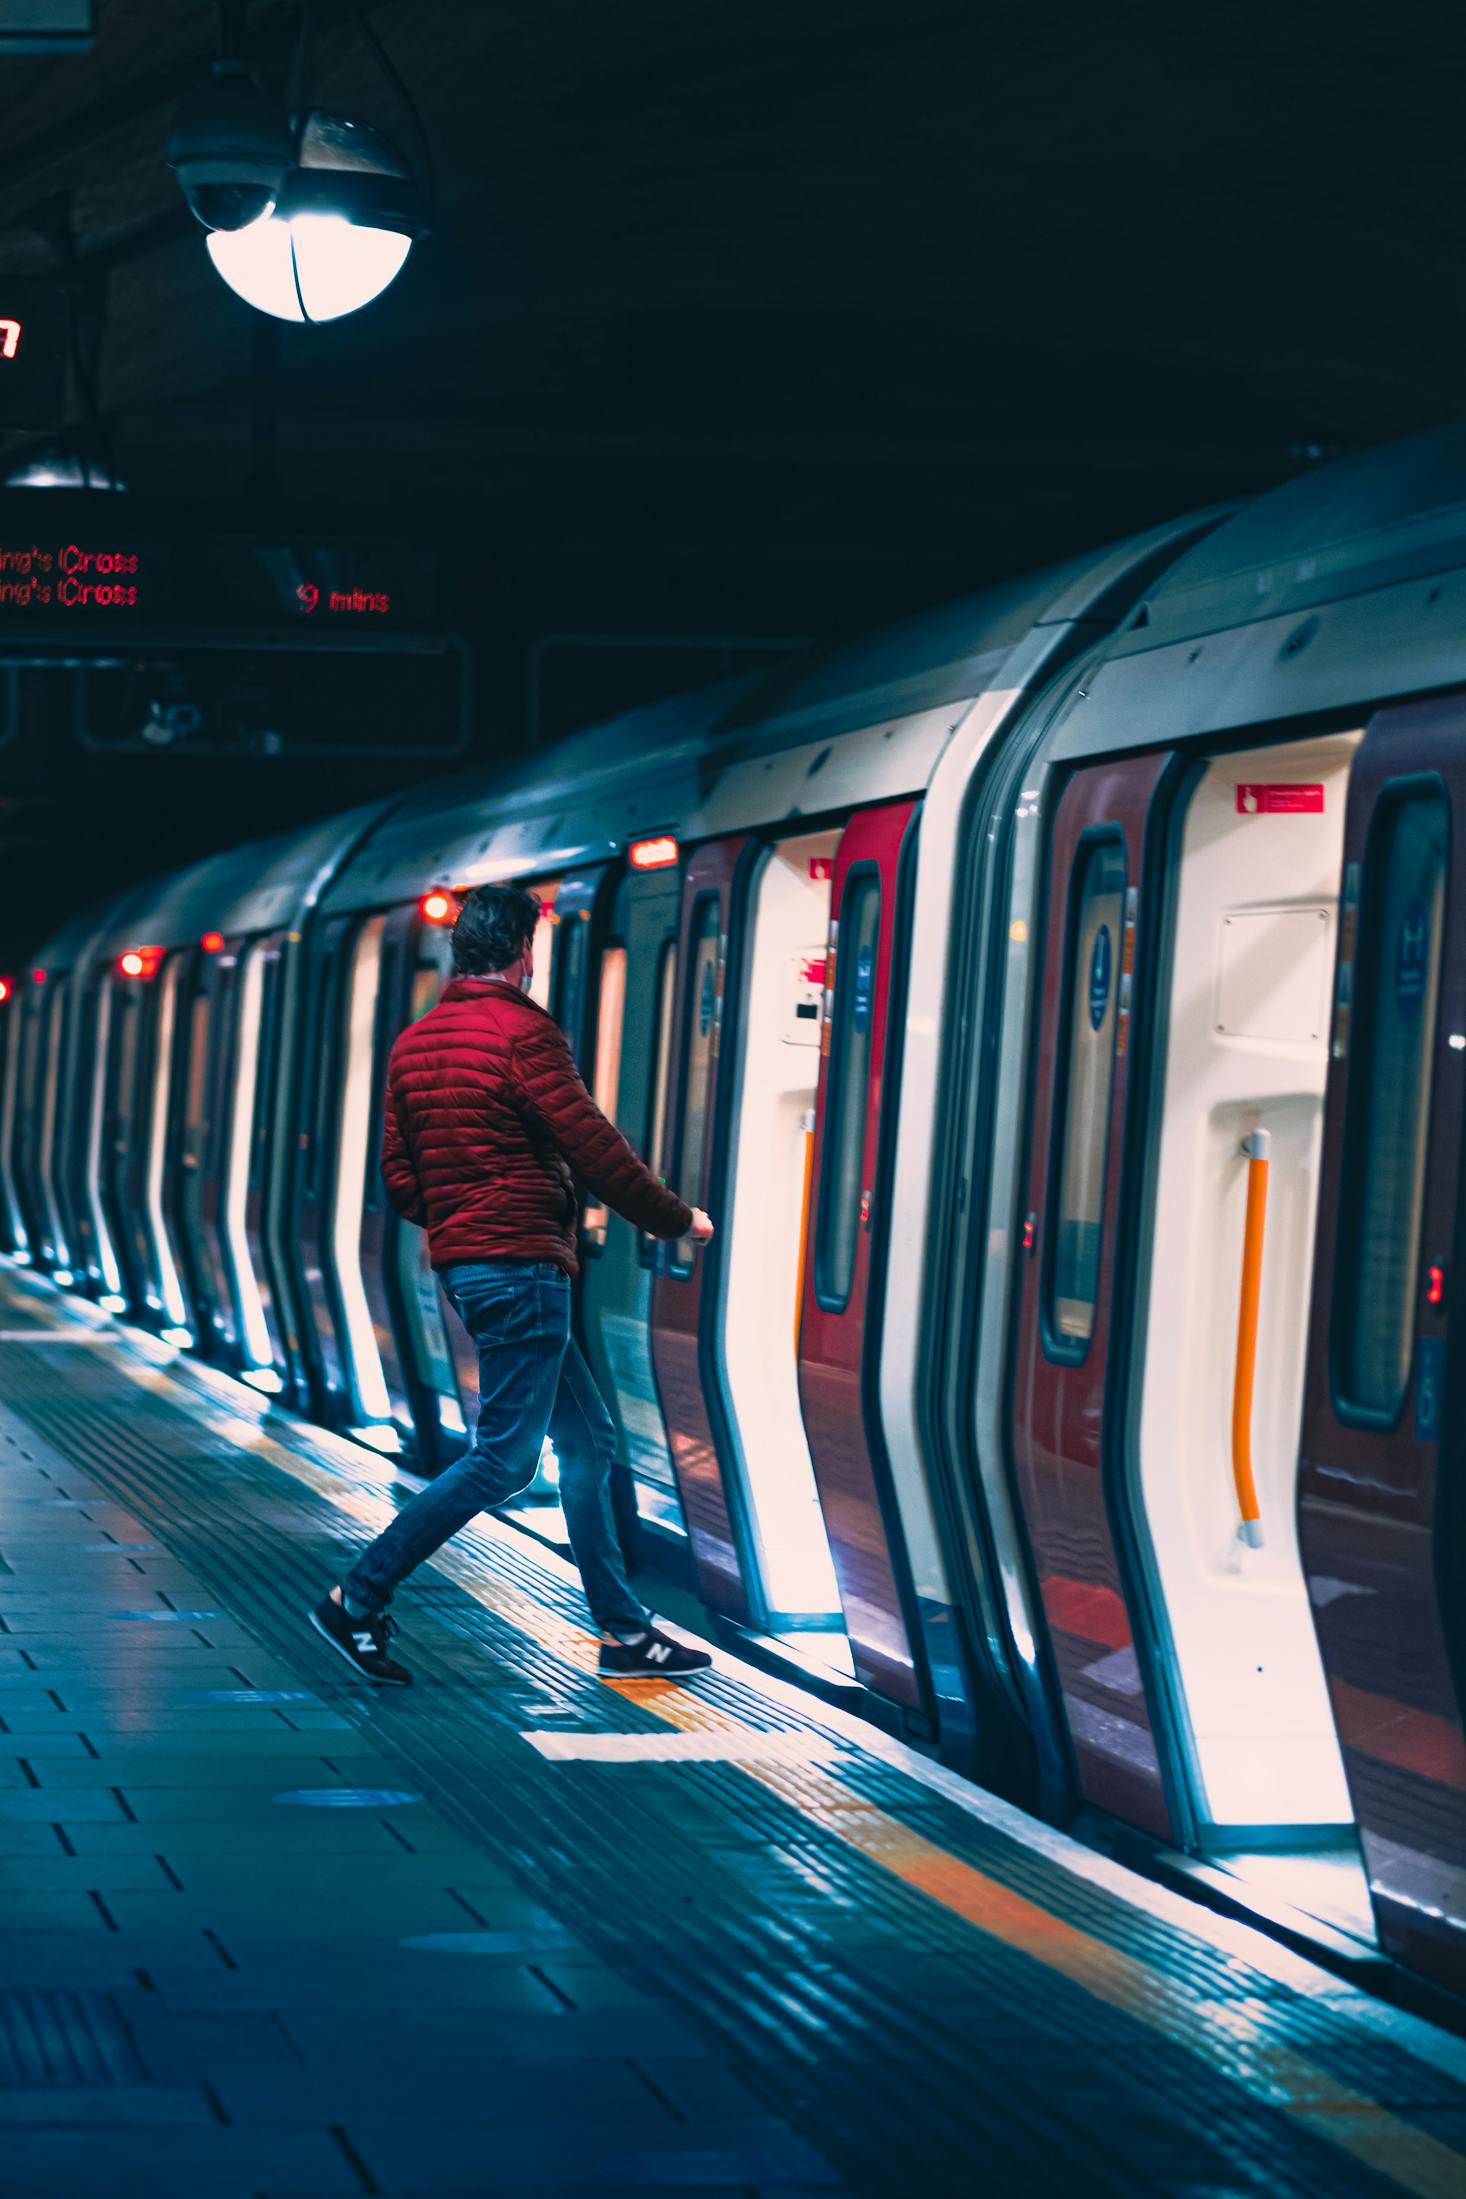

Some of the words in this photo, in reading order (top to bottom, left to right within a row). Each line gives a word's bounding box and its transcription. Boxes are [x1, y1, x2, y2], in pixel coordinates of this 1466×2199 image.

[58, 544, 138, 575] Cross
[57, 577, 138, 607] Cross
[296, 584, 319, 614] 9
[329, 587, 389, 613] mins
[351, 1631, 378, 1652] N
[645, 1642, 672, 1664] N
